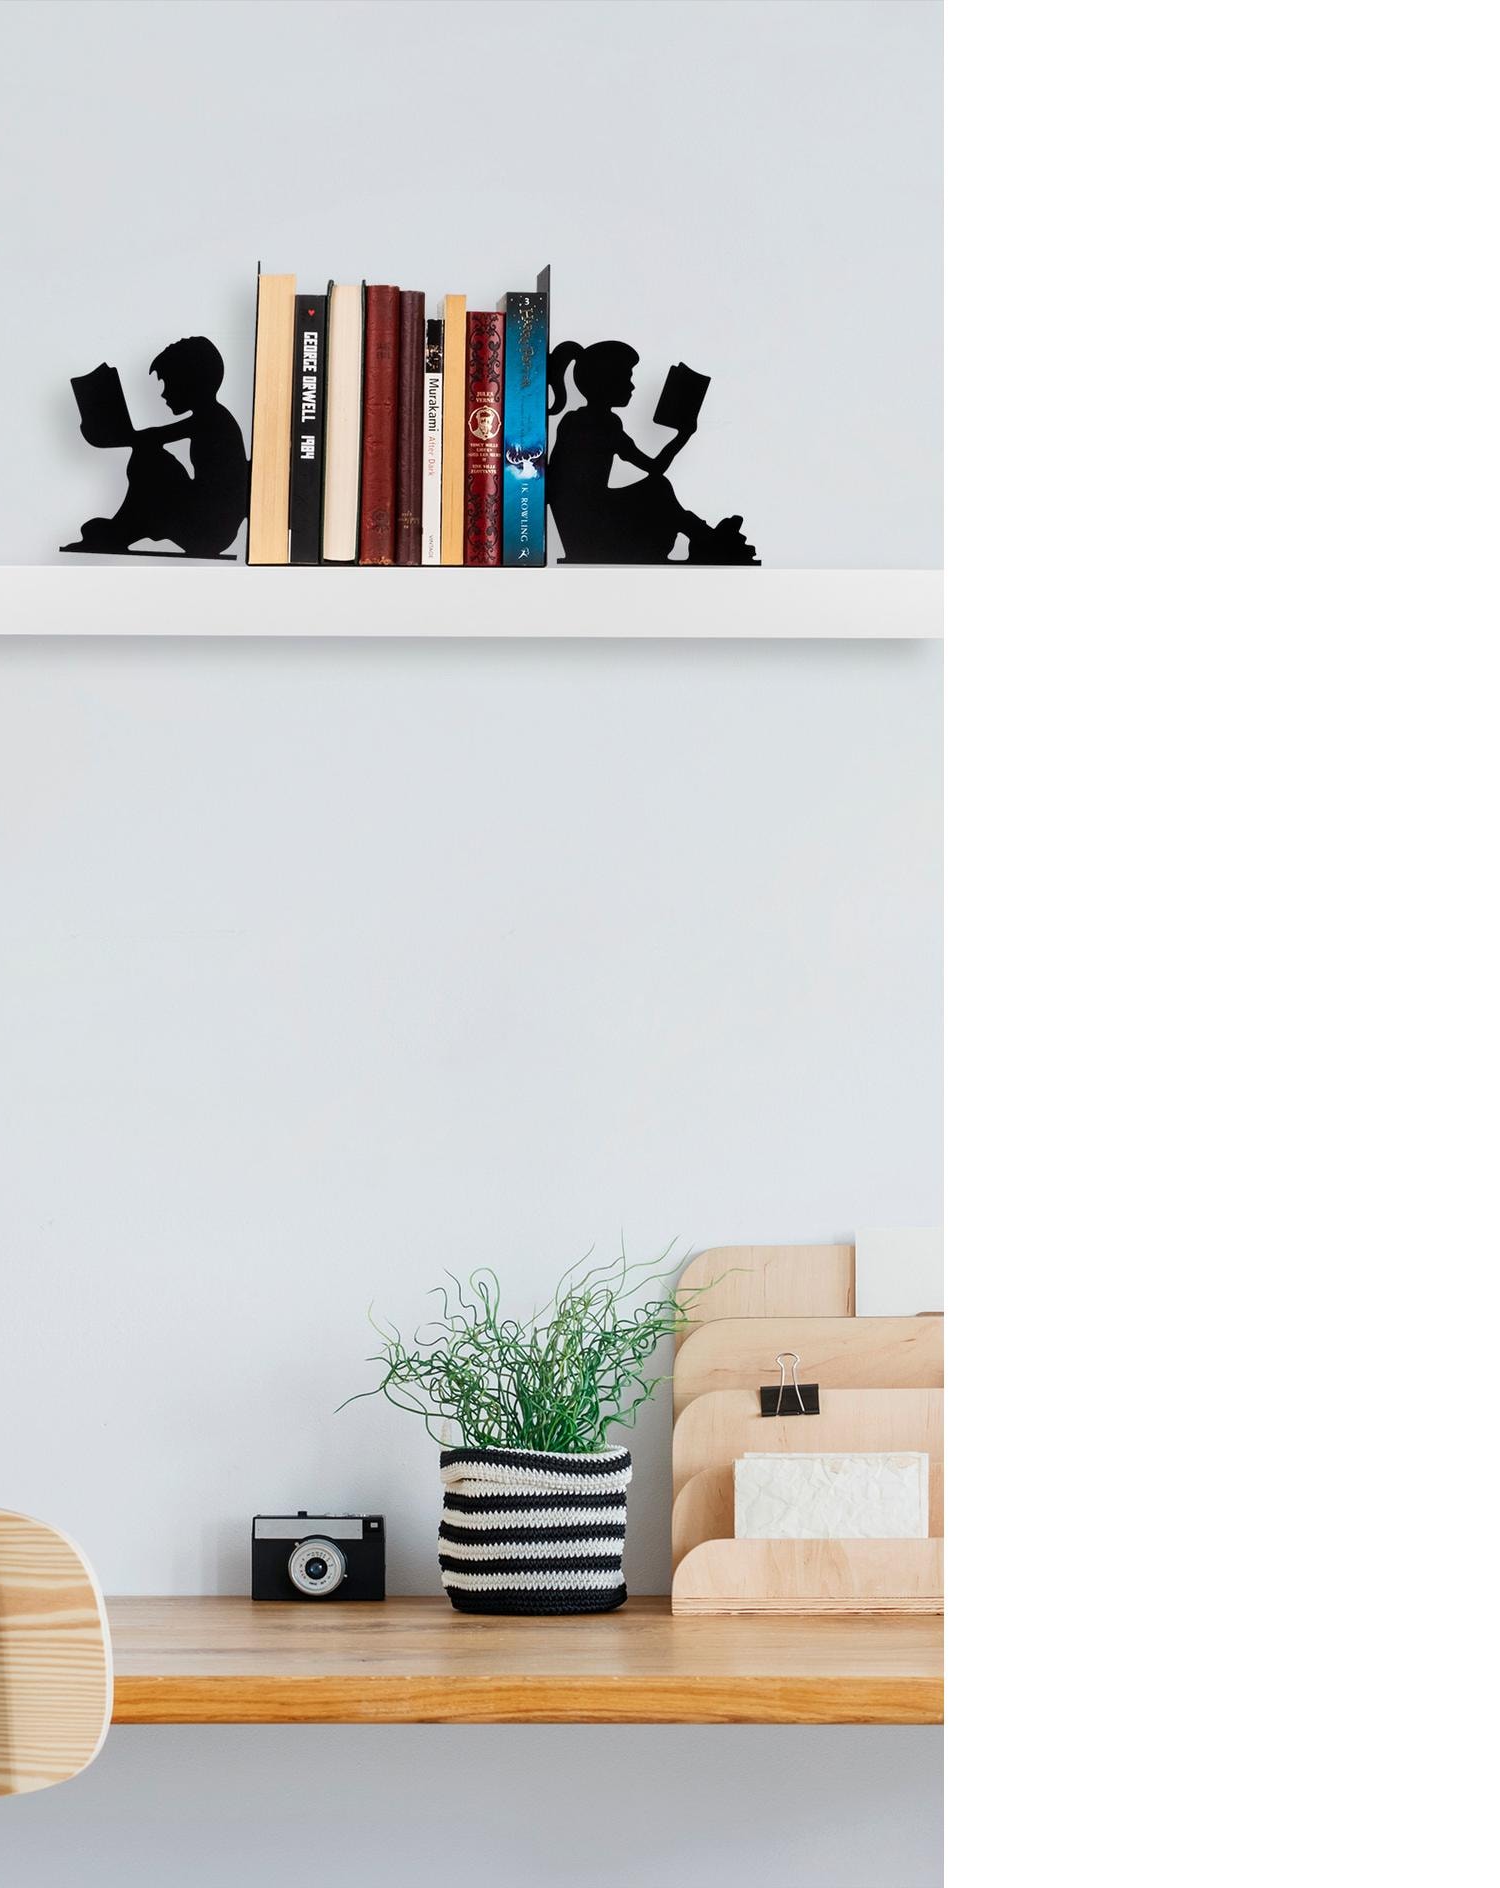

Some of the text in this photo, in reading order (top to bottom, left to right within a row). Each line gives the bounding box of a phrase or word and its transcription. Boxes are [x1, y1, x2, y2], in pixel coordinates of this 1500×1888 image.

[524, 297, 530, 306] 3
[301, 331, 318, 423] GEORGE ORWELL
[428, 378, 440, 432] Murakami
[300, 435, 315, 459] 1984
[428, 436, 436, 476] After Dark
[520, 497, 529, 542] ROWLING
